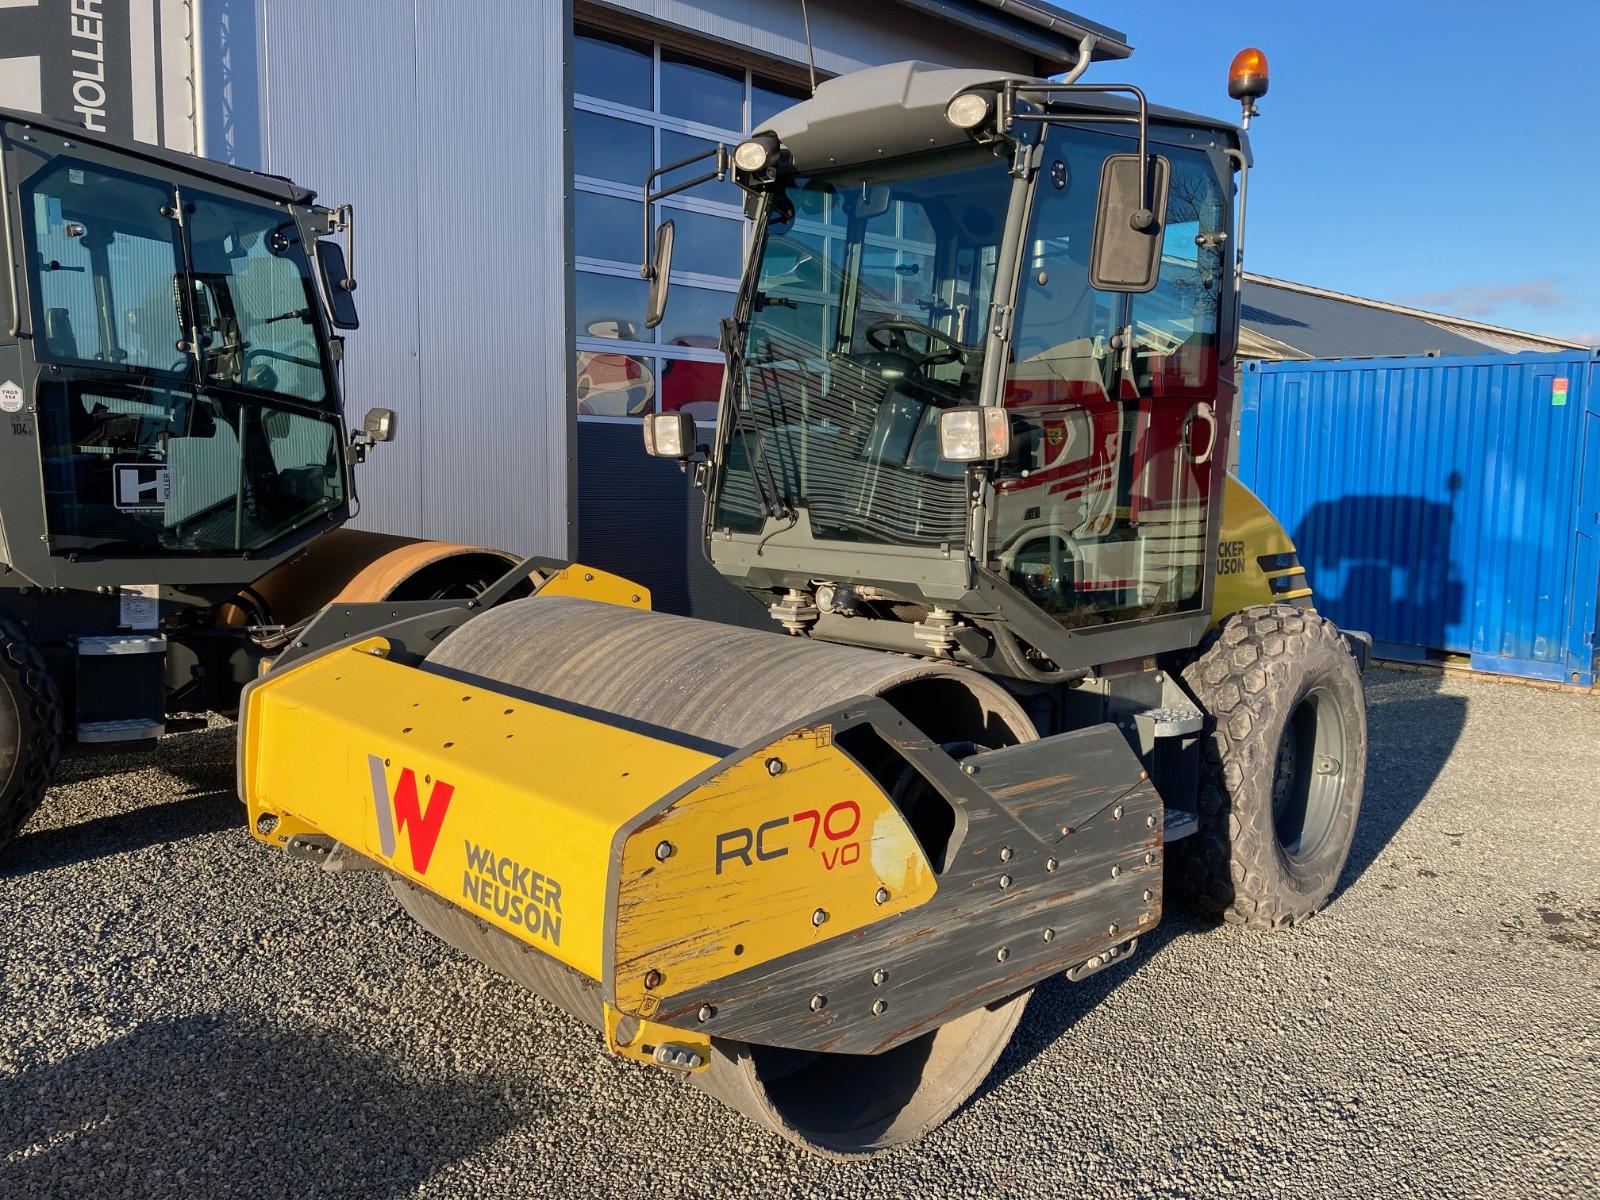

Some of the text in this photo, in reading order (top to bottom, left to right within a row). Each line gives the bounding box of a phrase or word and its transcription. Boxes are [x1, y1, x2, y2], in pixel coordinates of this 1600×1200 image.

[71, 0, 107, 132] HOLLER
[11, 423, 28, 435] 104
[163, 473, 171, 500] HOLLER
[464, 839, 562, 914] WACKER
[821, 841, 861, 871] VO
[462, 870, 562, 947] NEUSON
